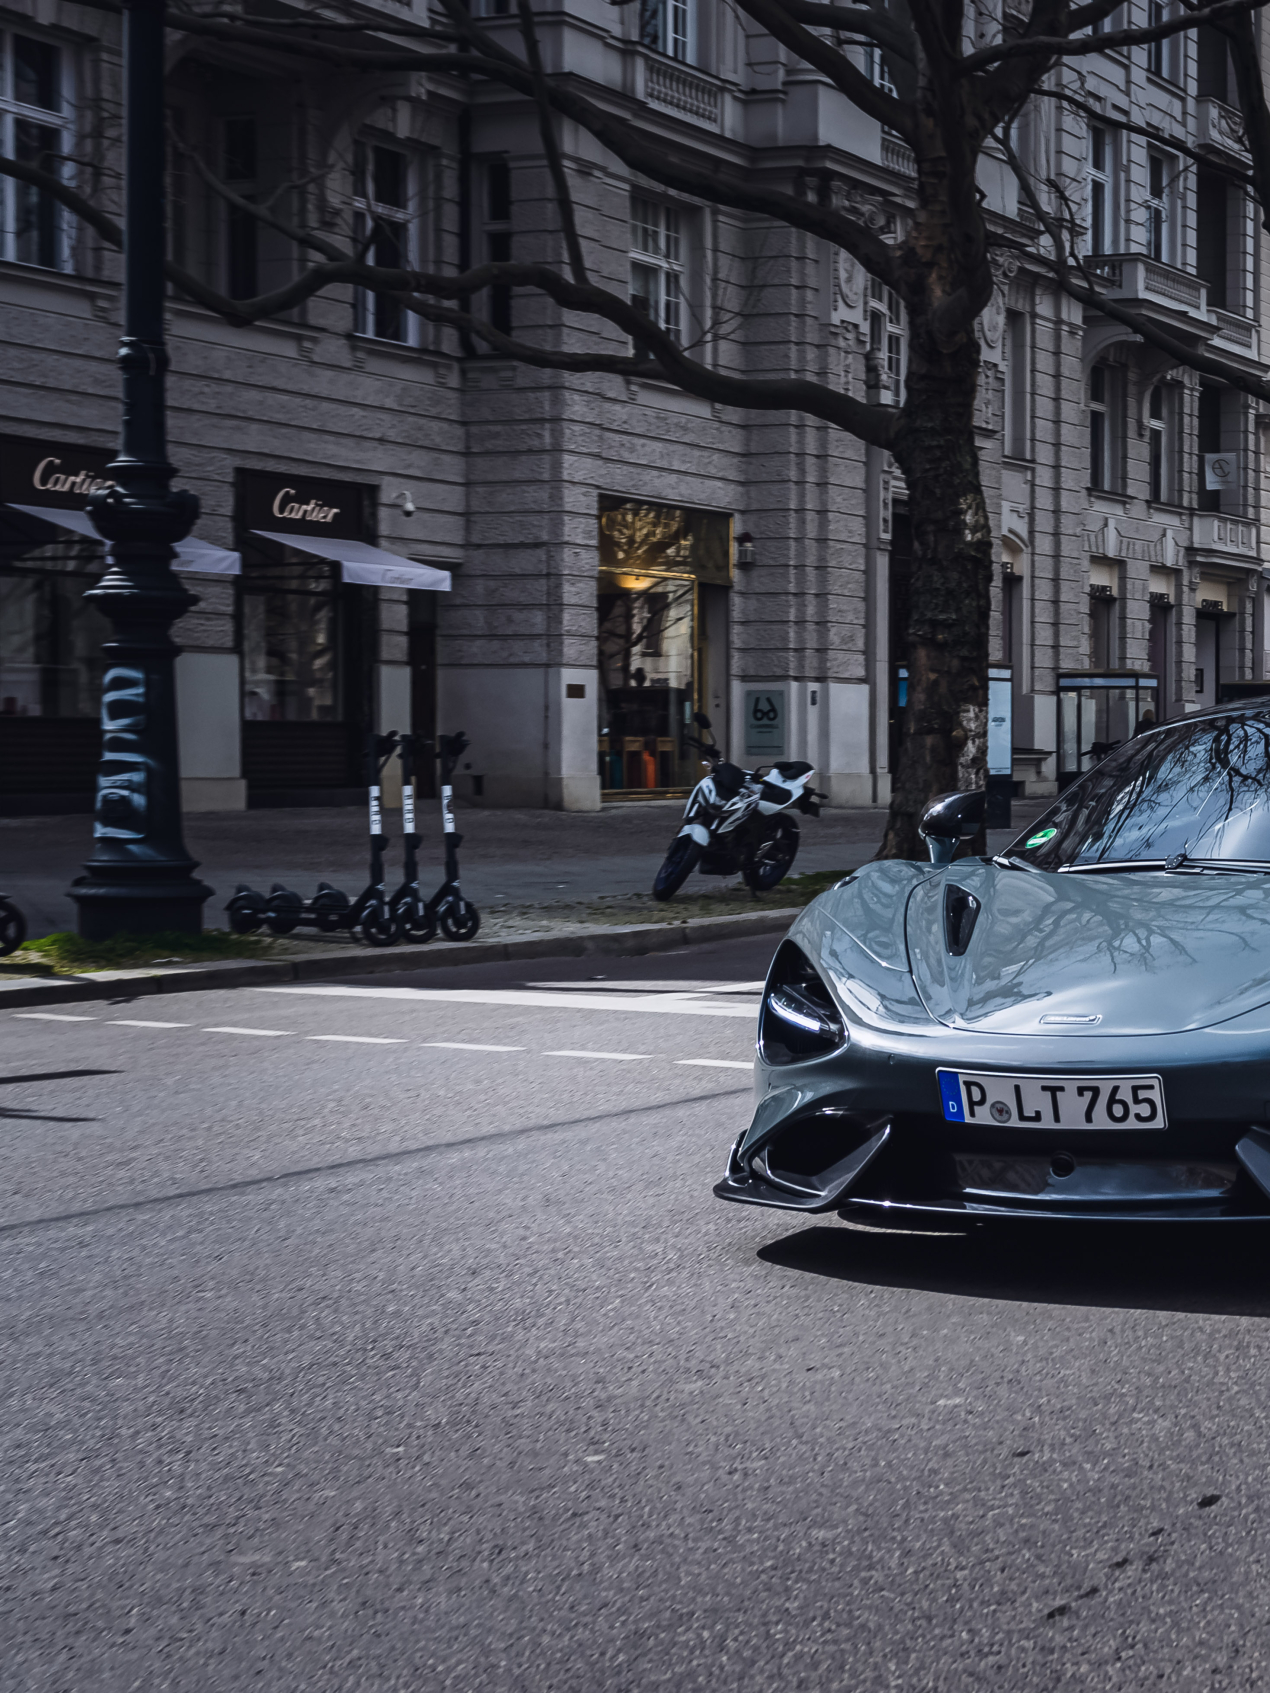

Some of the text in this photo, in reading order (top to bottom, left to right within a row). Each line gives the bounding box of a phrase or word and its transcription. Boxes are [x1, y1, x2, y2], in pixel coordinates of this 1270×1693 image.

[272, 488, 341, 523] Cartier
[949, 1080, 1158, 1124] D P LT 765
